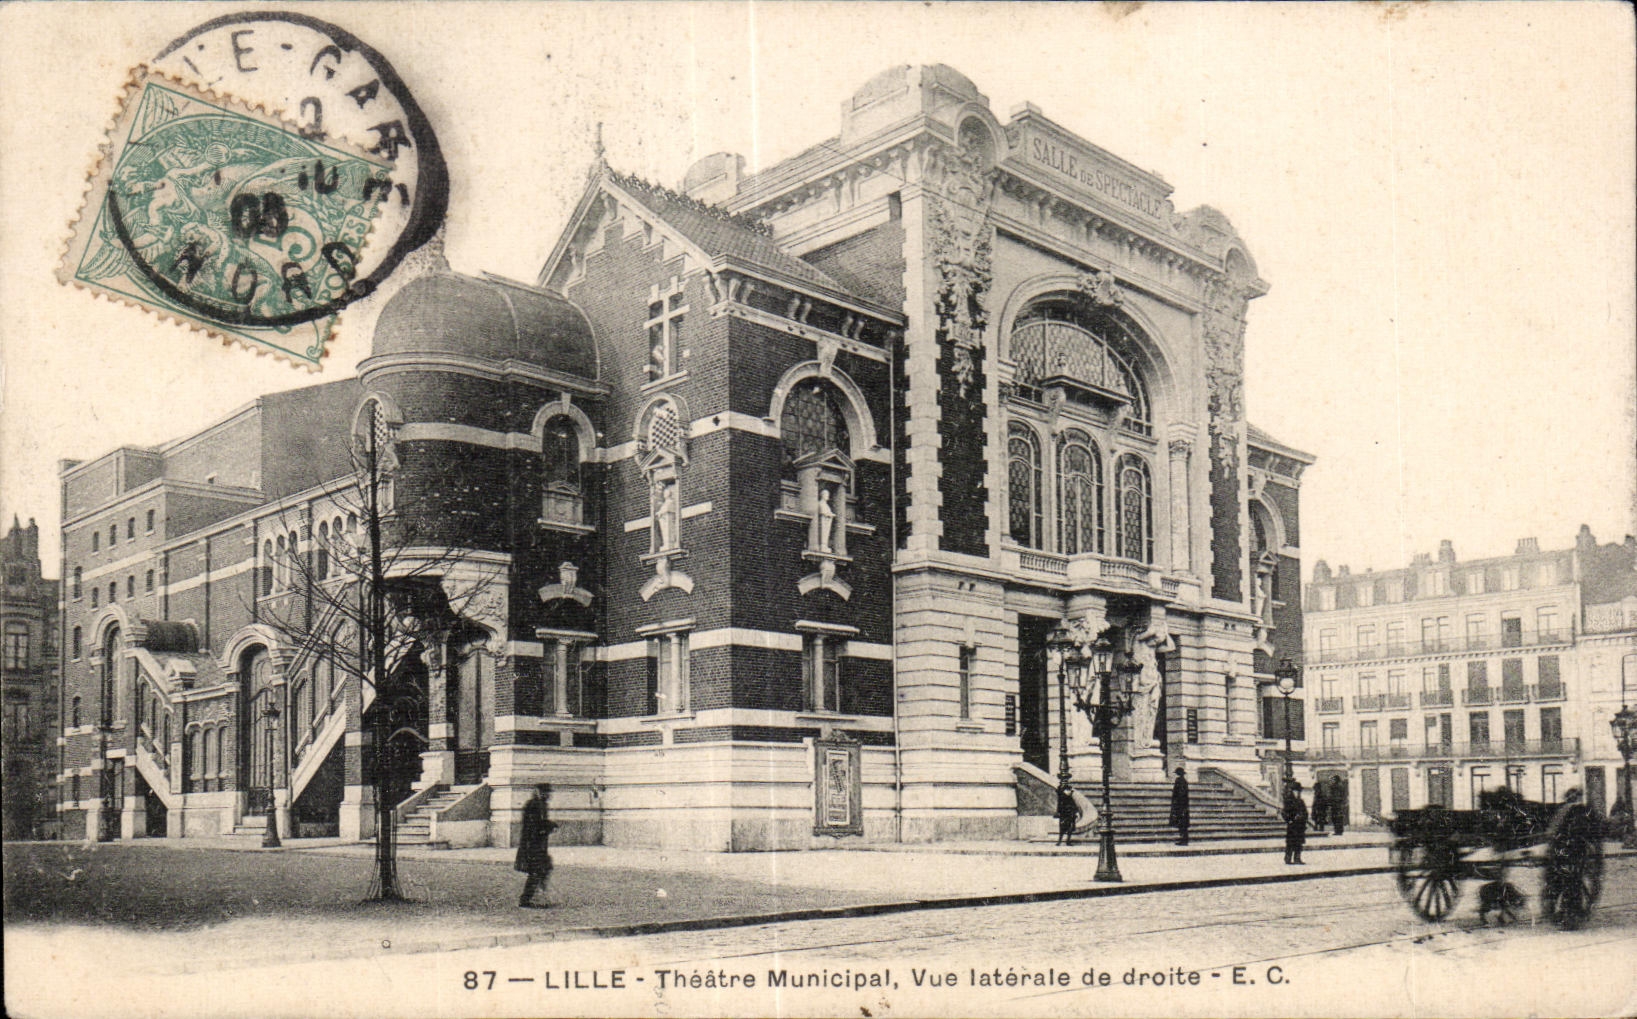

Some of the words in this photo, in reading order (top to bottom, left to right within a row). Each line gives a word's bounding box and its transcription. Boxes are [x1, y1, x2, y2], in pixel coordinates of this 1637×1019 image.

[1033, 138, 1078, 179] SALLE
[1081, 170, 1094, 187] DE
[1095, 168, 1162, 219] SPECTACLE
